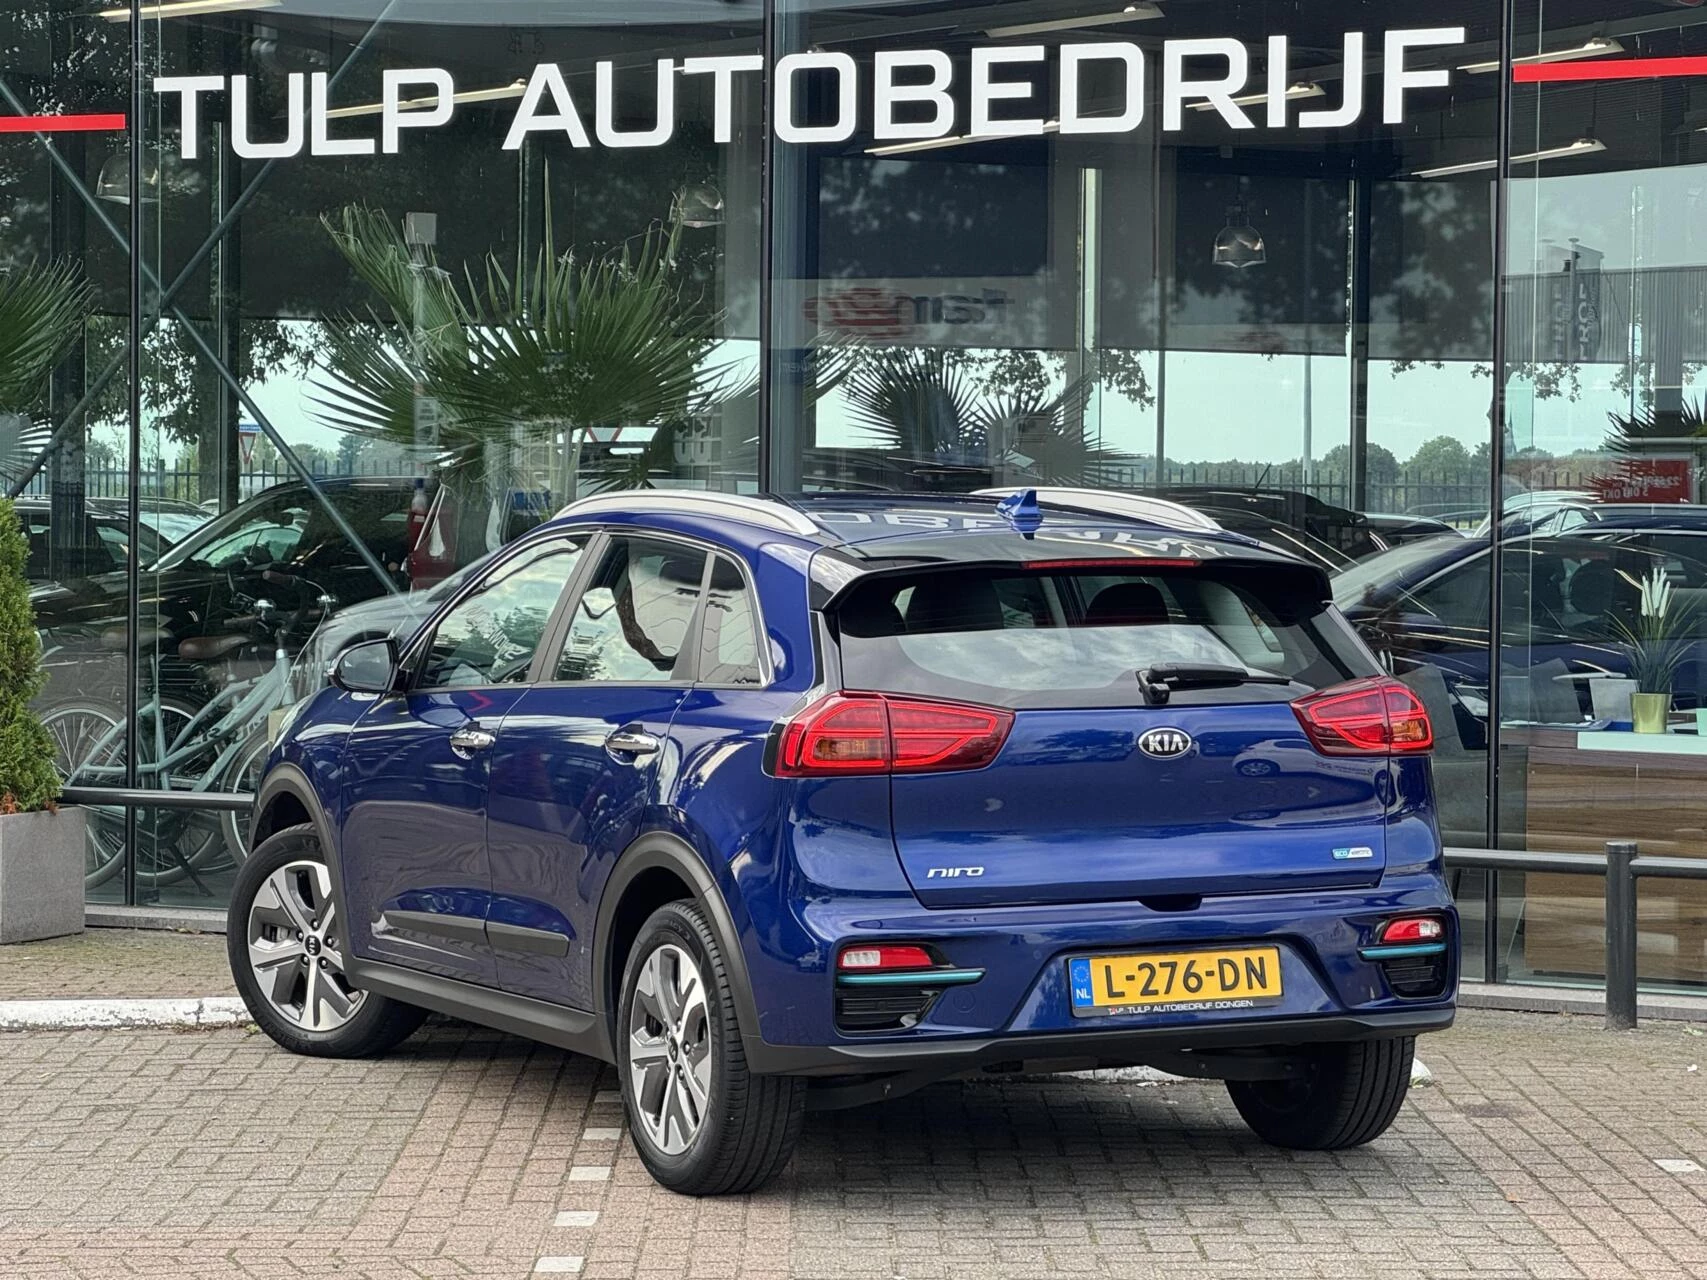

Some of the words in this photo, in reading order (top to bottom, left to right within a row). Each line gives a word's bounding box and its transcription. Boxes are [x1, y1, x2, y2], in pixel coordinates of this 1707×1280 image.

[153, 68, 454, 160] TULP
[501, 27, 1465, 150] AUTOBEDRIJF
[1148, 734, 1184, 751] KIA
[927, 867, 985, 878] niro
[1105, 957, 1267, 998] L-276-DN
[1076, 988, 1091, 999] NL
[1127, 1006, 1151, 1014] TULP
[1153, 1001, 1213, 1012] AUTOBEDRIJF
[1215, 999, 1254, 1009] DONGEN
